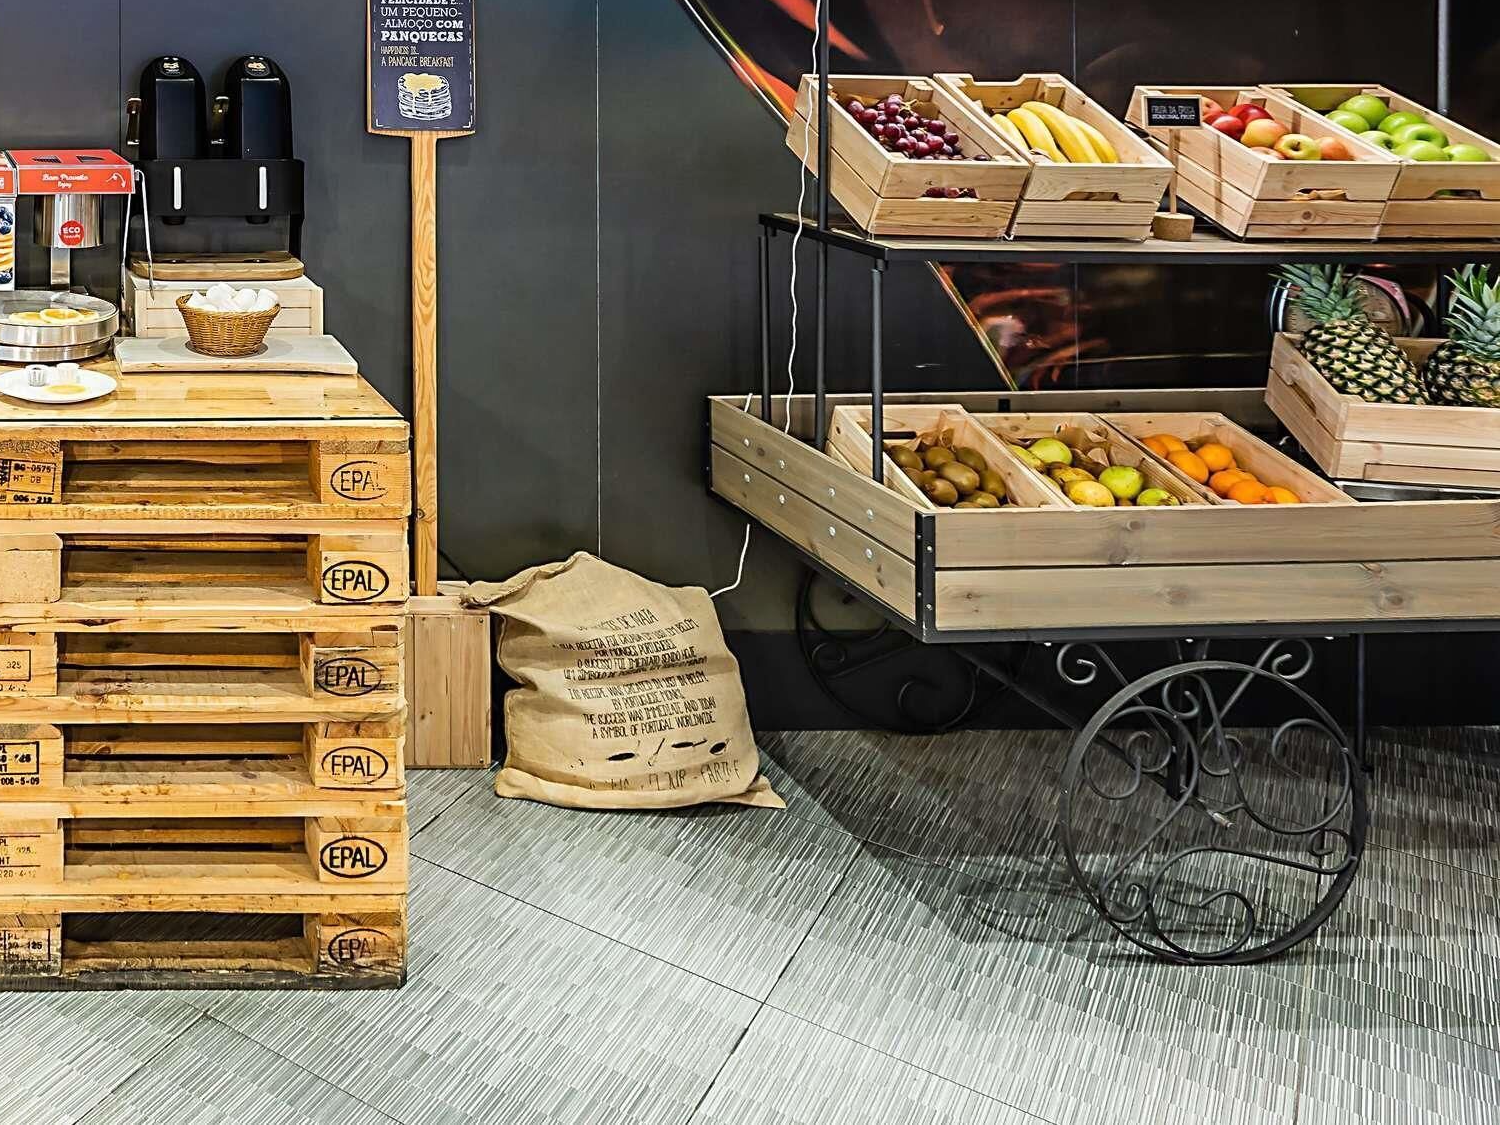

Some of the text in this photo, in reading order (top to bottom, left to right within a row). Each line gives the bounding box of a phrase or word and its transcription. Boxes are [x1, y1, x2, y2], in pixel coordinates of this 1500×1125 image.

[380, 7, 462, 18] UM PEQUENO-
[381, 19, 464, 30] -ALMOÇO COM
[380, 31, 464, 43] PANQUECAS
[381, 57, 454, 68] A PANCAKE BREAKFAST
[341, 471, 385, 491] EPAL
[331, 570, 378, 592] EPAL
[325, 666, 371, 687] EPAL
[592, 726, 598, 739] A
[600, 725, 628, 739] SYMBOL
[630, 724, 638, 736] OF
[641, 718, 674, 734] PORTUGAL
[331, 755, 377, 778] EPAL
[329, 846, 375, 869] EPAL
